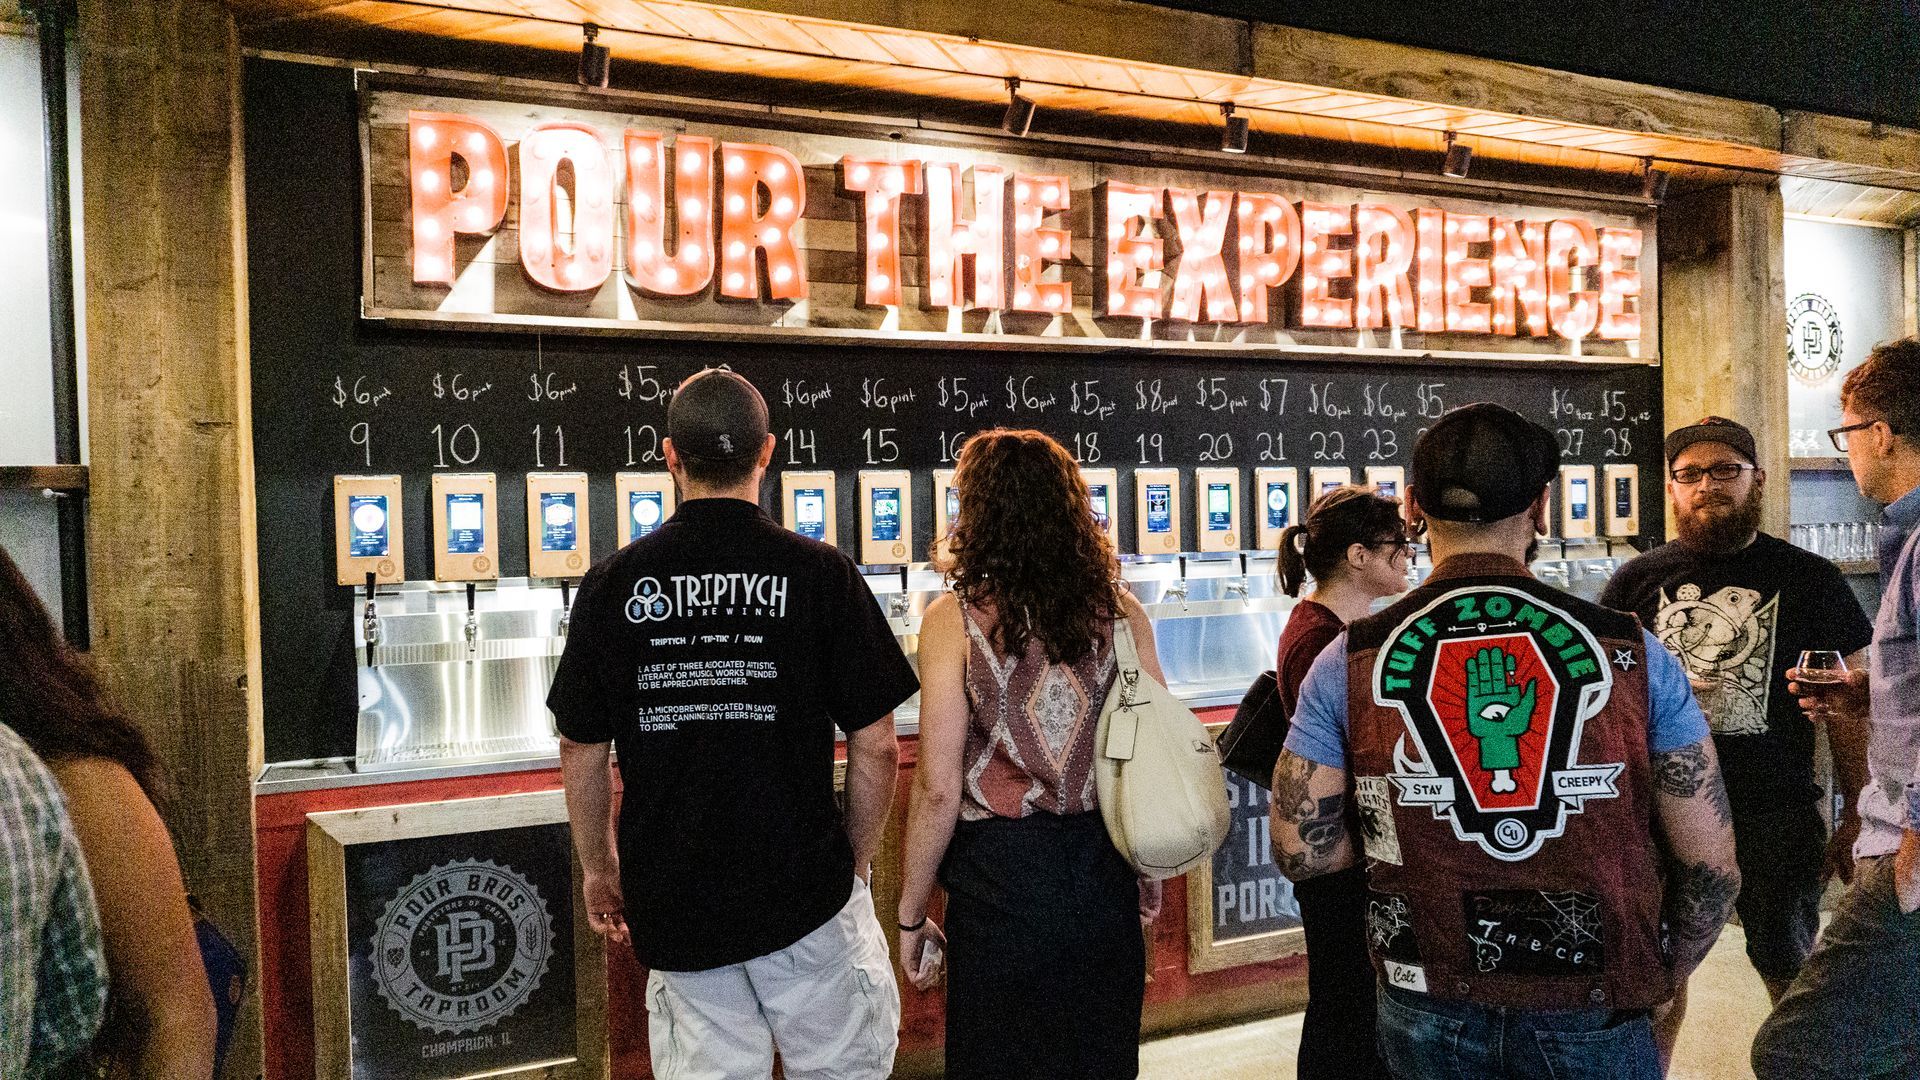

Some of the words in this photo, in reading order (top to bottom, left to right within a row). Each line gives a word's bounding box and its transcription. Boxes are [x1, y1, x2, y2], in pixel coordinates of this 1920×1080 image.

[408, 110, 807, 301] POUR
[840, 153, 1072, 314] THE
[1100, 179, 1643, 341] EXPERIENCE
[332, 375, 370, 408] $6
[433, 372, 469, 401] $6
[527, 372, 559, 401] $6
[619, 364, 660, 401] $5
[782, 378, 810, 409] $6
[860, 377, 888, 408] $6
[938, 376, 969, 412] $5
[1005, 376, 1039, 412] $6
[1070, 380, 1100, 416] $5
[1135, 378, 1162, 412] $8
[1196, 377, 1228, 411] $5
[1259, 377, 1289, 416] $7
[1309, 382, 1337, 417] $6
[1364, 382, 1393, 417] $6
[1416, 382, 1446, 418] $5
[1549, 386, 1574, 419] $6
[1600, 389, 1627, 421] $5
[350, 422, 371, 467] 9
[431, 424, 480, 468] 10
[532, 424, 568, 467] 11
[624, 425, 665, 466] 12
[784, 428, 817, 464] 14
[862, 428, 899, 464] 15
[1074, 432, 1101, 463] 18
[1136, 433, 1163, 464] 19
[1199, 432, 1233, 461] 20
[1256, 432, 1288, 461] 21
[1310, 431, 1345, 460] 22
[1363, 429, 1398, 460] 23
[1557, 428, 1584, 457] 27
[1604, 428, 1632, 457] 28
[670, 573, 788, 618] TRIPTYCH
[687, 607, 776, 617] BREWING
[650, 636, 687, 646] TRIPTYCH
[1385, 616, 1438, 692] TUFF
[1454, 596, 1598, 679] ZOMBIE
[651, 663, 665, 672] SET
[667, 663, 677, 671] OF
[678, 661, 704, 670] THREE
[676, 670, 688, 679] OR
[715, 669, 745, 677] WORKS
[638, 682, 649, 690] TO
[650, 680, 661, 689] BE
[639, 707, 646, 715] 2.
[709, 702, 744, 711] LOCATED
[745, 703, 753, 711] IN
[639, 714, 671, 724] ILLINOIS
[725, 711, 749, 720] BEERS
[750, 713, 763, 721] FOR
[765, 713, 776, 721] ME
[640, 723, 651, 731] TO
[652, 722, 678, 731] DRINK.
[1413, 783, 1443, 796] STAY
[1558, 775, 1602, 788] CREEPY
[393, 877, 453, 931] POUR
[1393, 966, 1416, 984] Colt
[404, 967, 527, 1017] TAPROOM
[500, 1031, 514, 1047] IL
